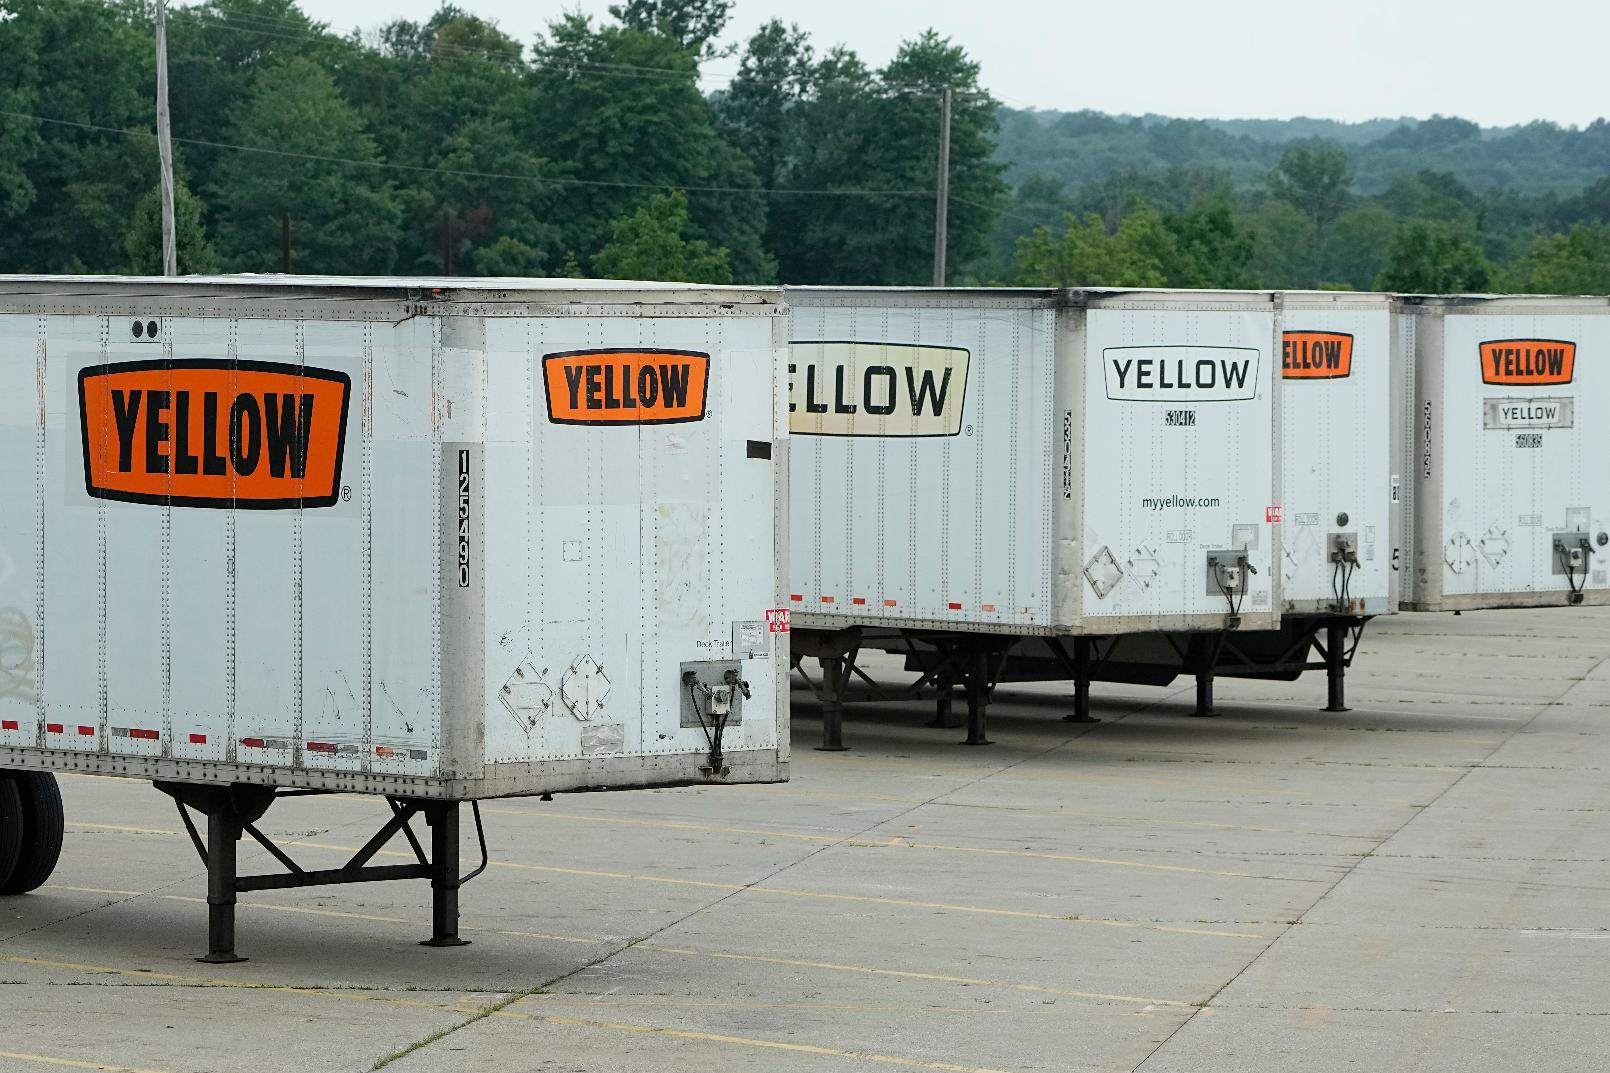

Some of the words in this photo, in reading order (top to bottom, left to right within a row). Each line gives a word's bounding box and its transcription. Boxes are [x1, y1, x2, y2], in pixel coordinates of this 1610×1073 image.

[1112, 359, 1250, 389] YELLOW
[1491, 348, 1565, 377] YELLOW
[563, 364, 691, 410] YELLOW
[1165, 410, 1196, 426] 530412
[1502, 406, 1557, 420] YELLOW
[111, 389, 315, 479] YELLOW
[1142, 494, 1220, 511] myyellow.com
[459, 450, 469, 587] 125490
